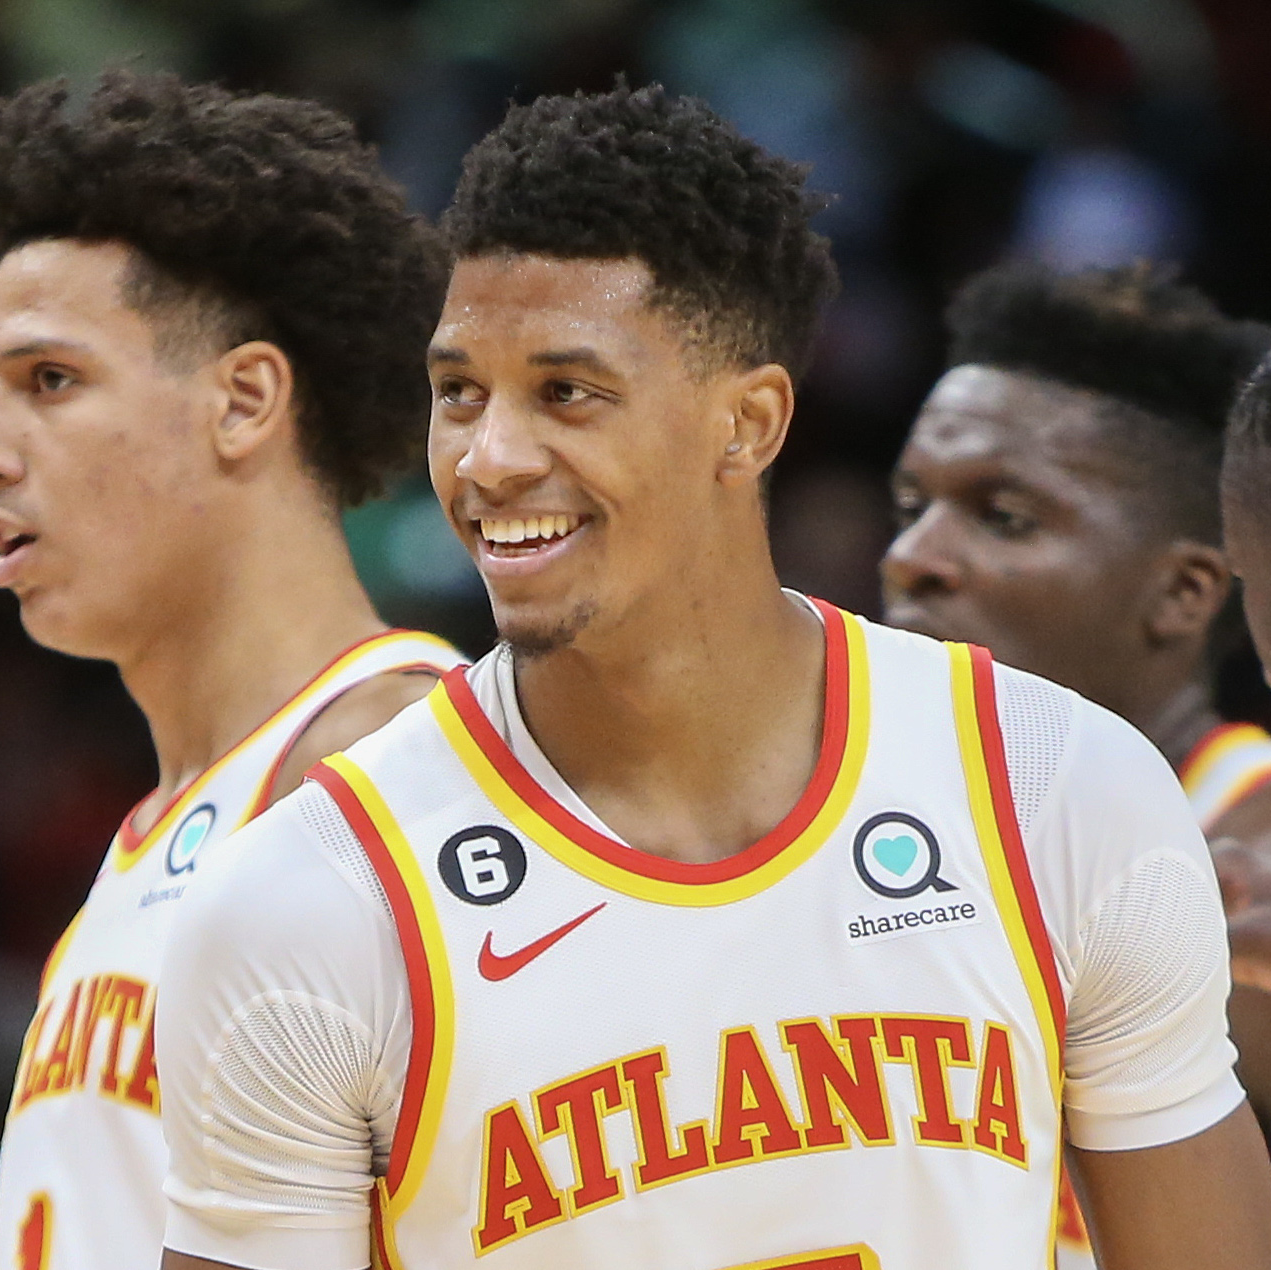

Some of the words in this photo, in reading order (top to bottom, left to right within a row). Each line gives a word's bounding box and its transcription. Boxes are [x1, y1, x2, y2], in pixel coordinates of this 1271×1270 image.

[455, 833, 513, 898] 6
[848, 899, 976, 941] sharecare
[470, 1012, 1030, 1258] ATLANTA
